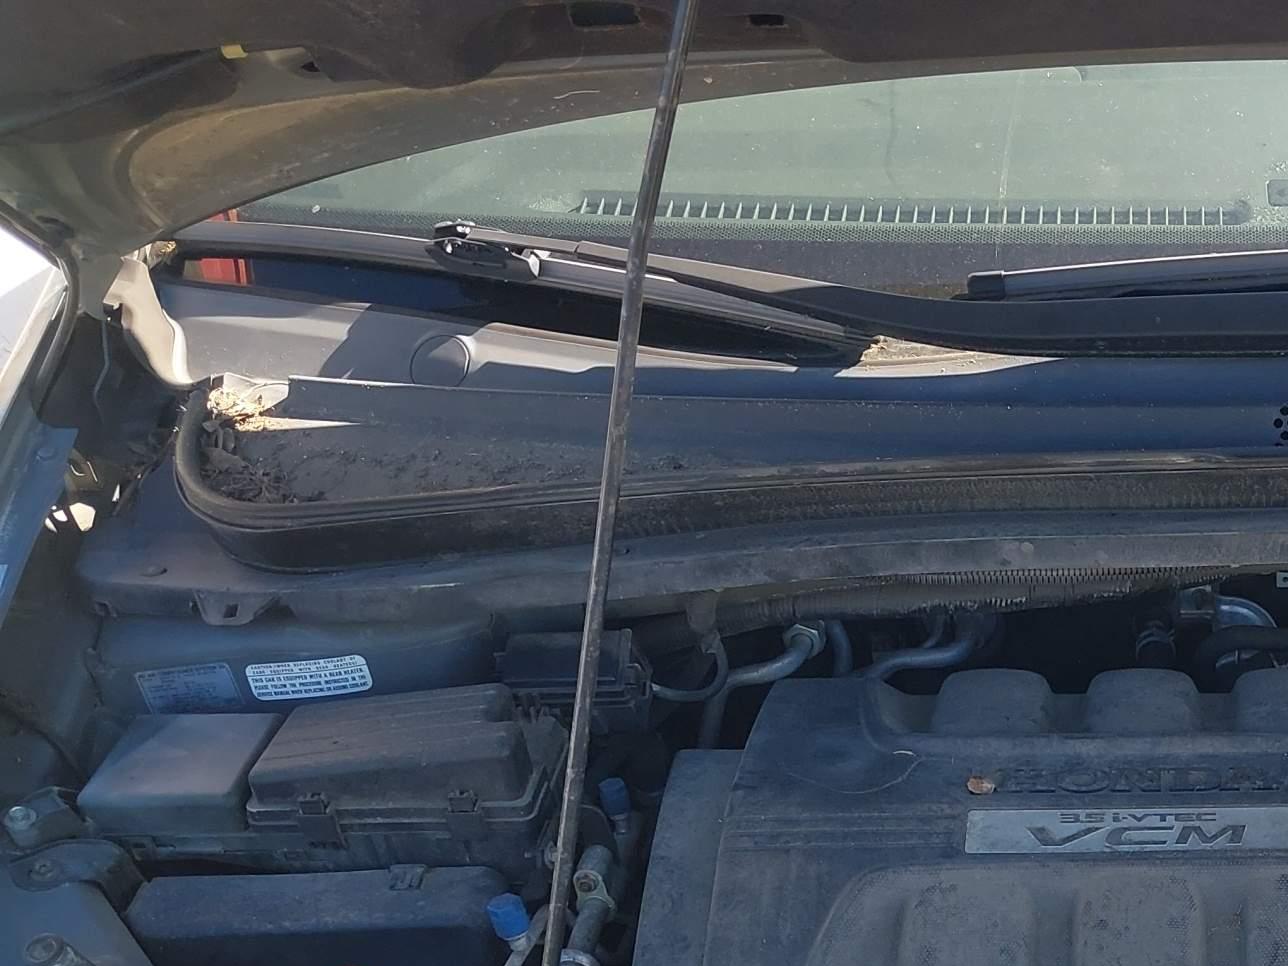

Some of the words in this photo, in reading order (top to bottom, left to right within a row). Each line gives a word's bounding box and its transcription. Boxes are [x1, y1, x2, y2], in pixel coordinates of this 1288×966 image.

[1006, 767, 1280, 793] HONDA
[1112, 811, 1217, 823] i-VTEC
[1025, 824, 1248, 848] VCM
